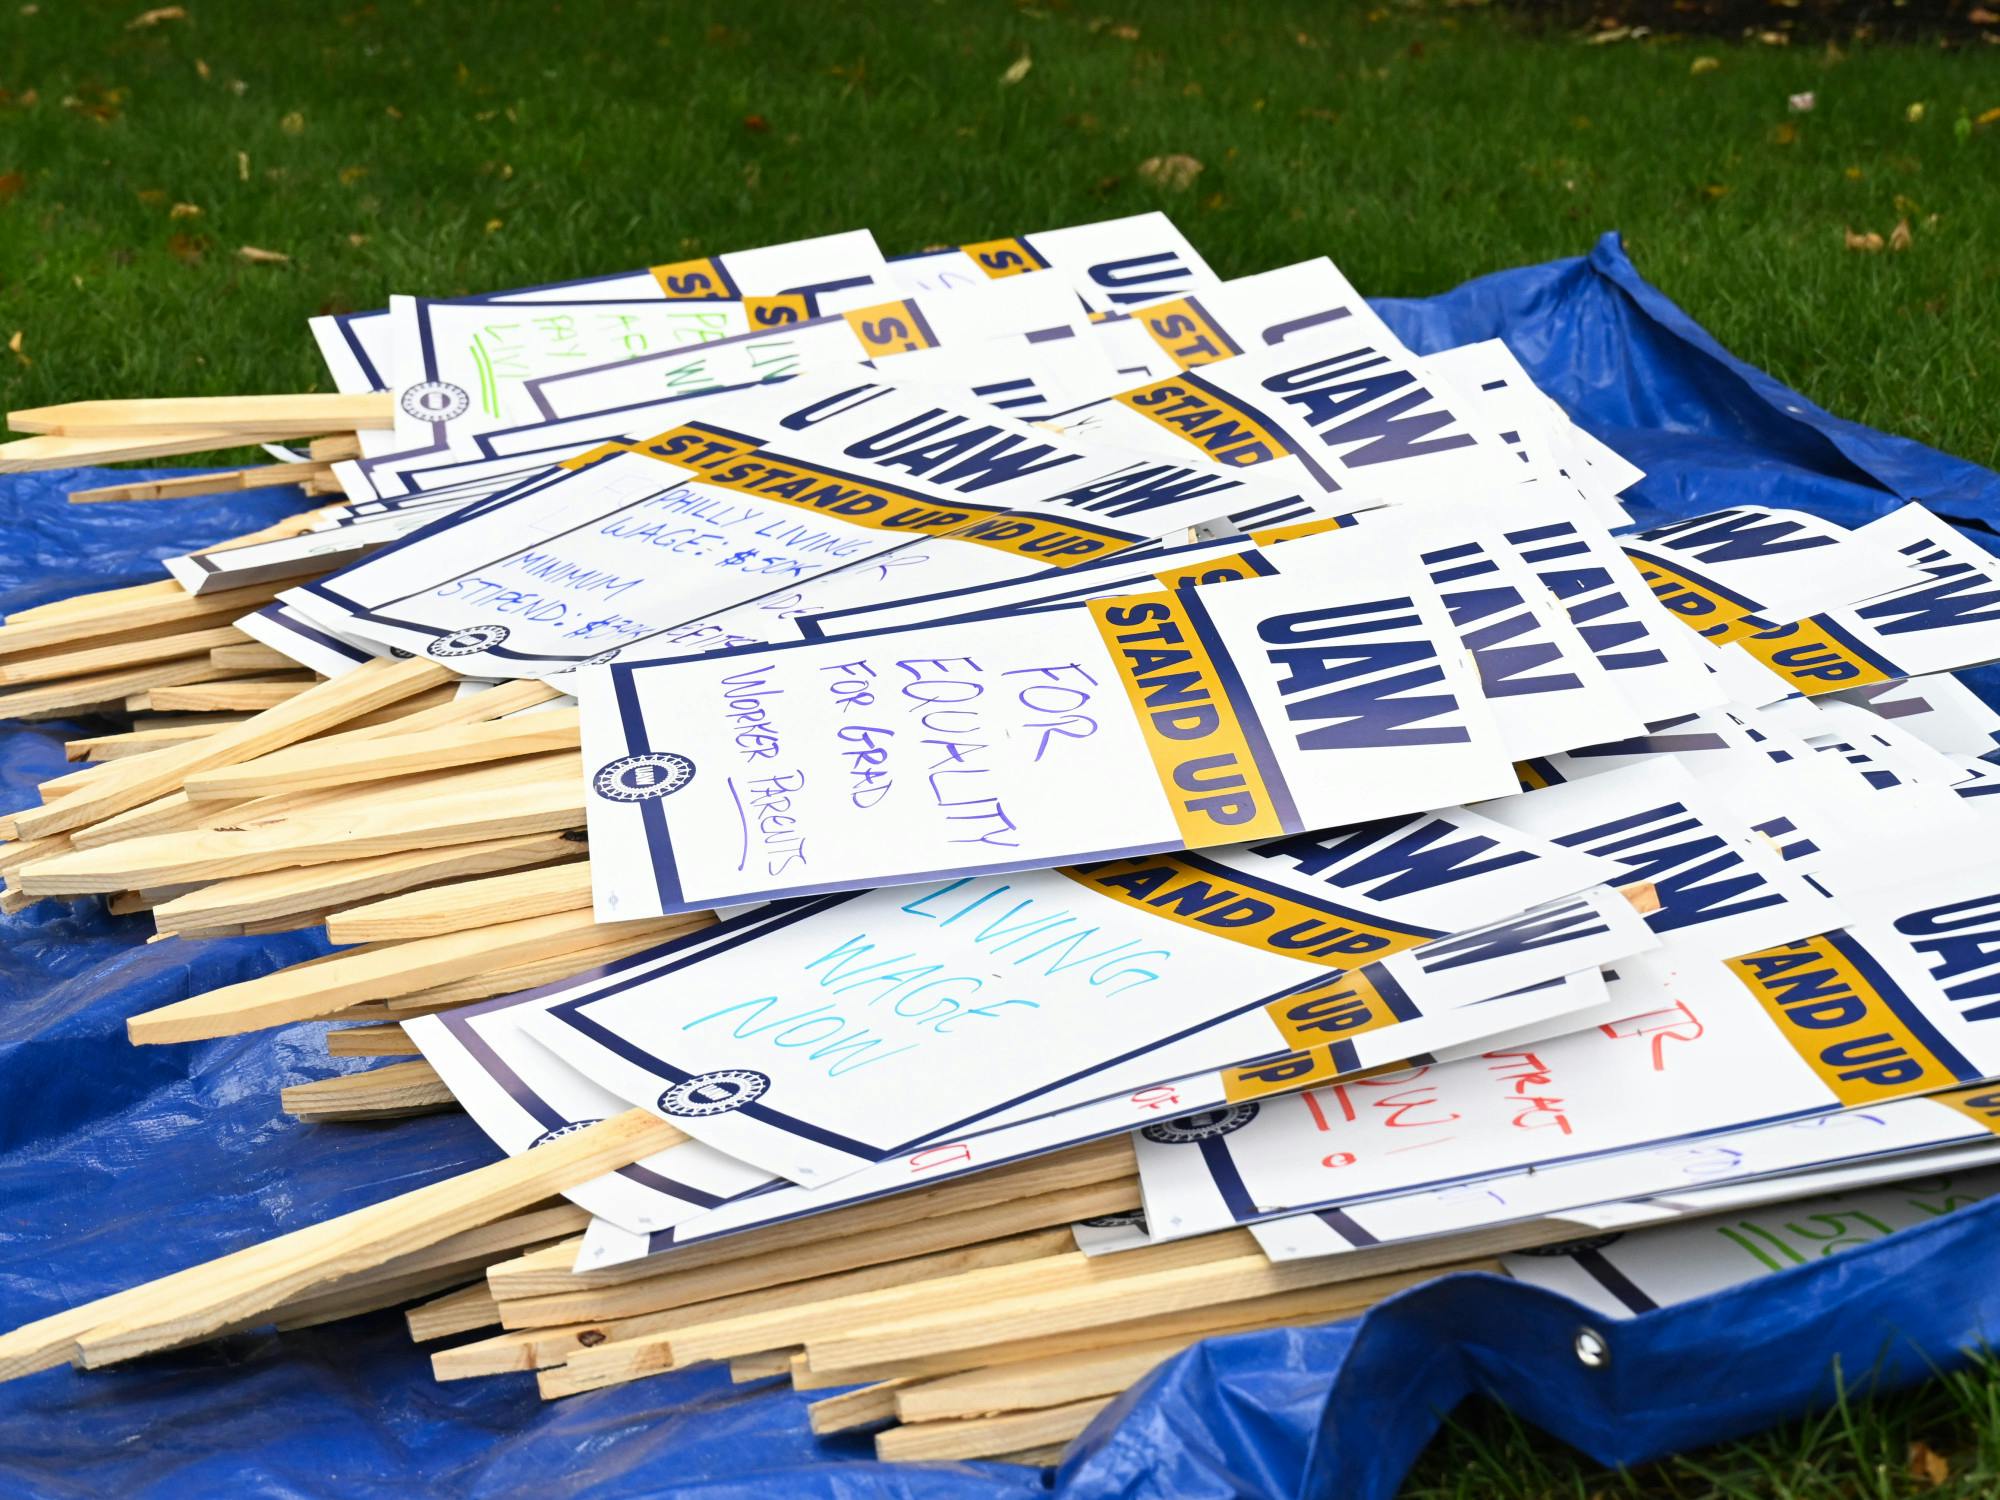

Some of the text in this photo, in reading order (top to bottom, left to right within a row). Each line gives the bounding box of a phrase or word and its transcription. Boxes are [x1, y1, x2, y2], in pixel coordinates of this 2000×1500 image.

[843, 408, 1085, 493] UAW
[1261, 346, 1478, 469] UAW
[641, 488, 765, 528] PHILLY
[755, 519, 872, 557] LIVING
[710, 463, 969, 530] STAND UP
[1040, 461, 1246, 518] AW
[502, 551, 645, 602] MINIMUM
[952, 519, 1105, 557] ND UP
[1256, 596, 1472, 751] UAW
[1771, 642, 1860, 682] UP
[818, 659, 896, 809] FOR GRAD
[895, 656, 1020, 847] EQUALITY
[1000, 661, 1099, 762] FOR
[1105, 602, 1222, 741] STAND
[1172, 753, 1257, 826] UP
[1247, 812, 1541, 902] AW
[1071, 859, 1391, 958] AND UP
[805, 933, 1041, 1033] WAGE
[1286, 989, 1373, 1032] UP
[1740, 938, 1868, 1030] AND
[1819, 1032, 1925, 1086] UP
[682, 995, 921, 1078] NOW
